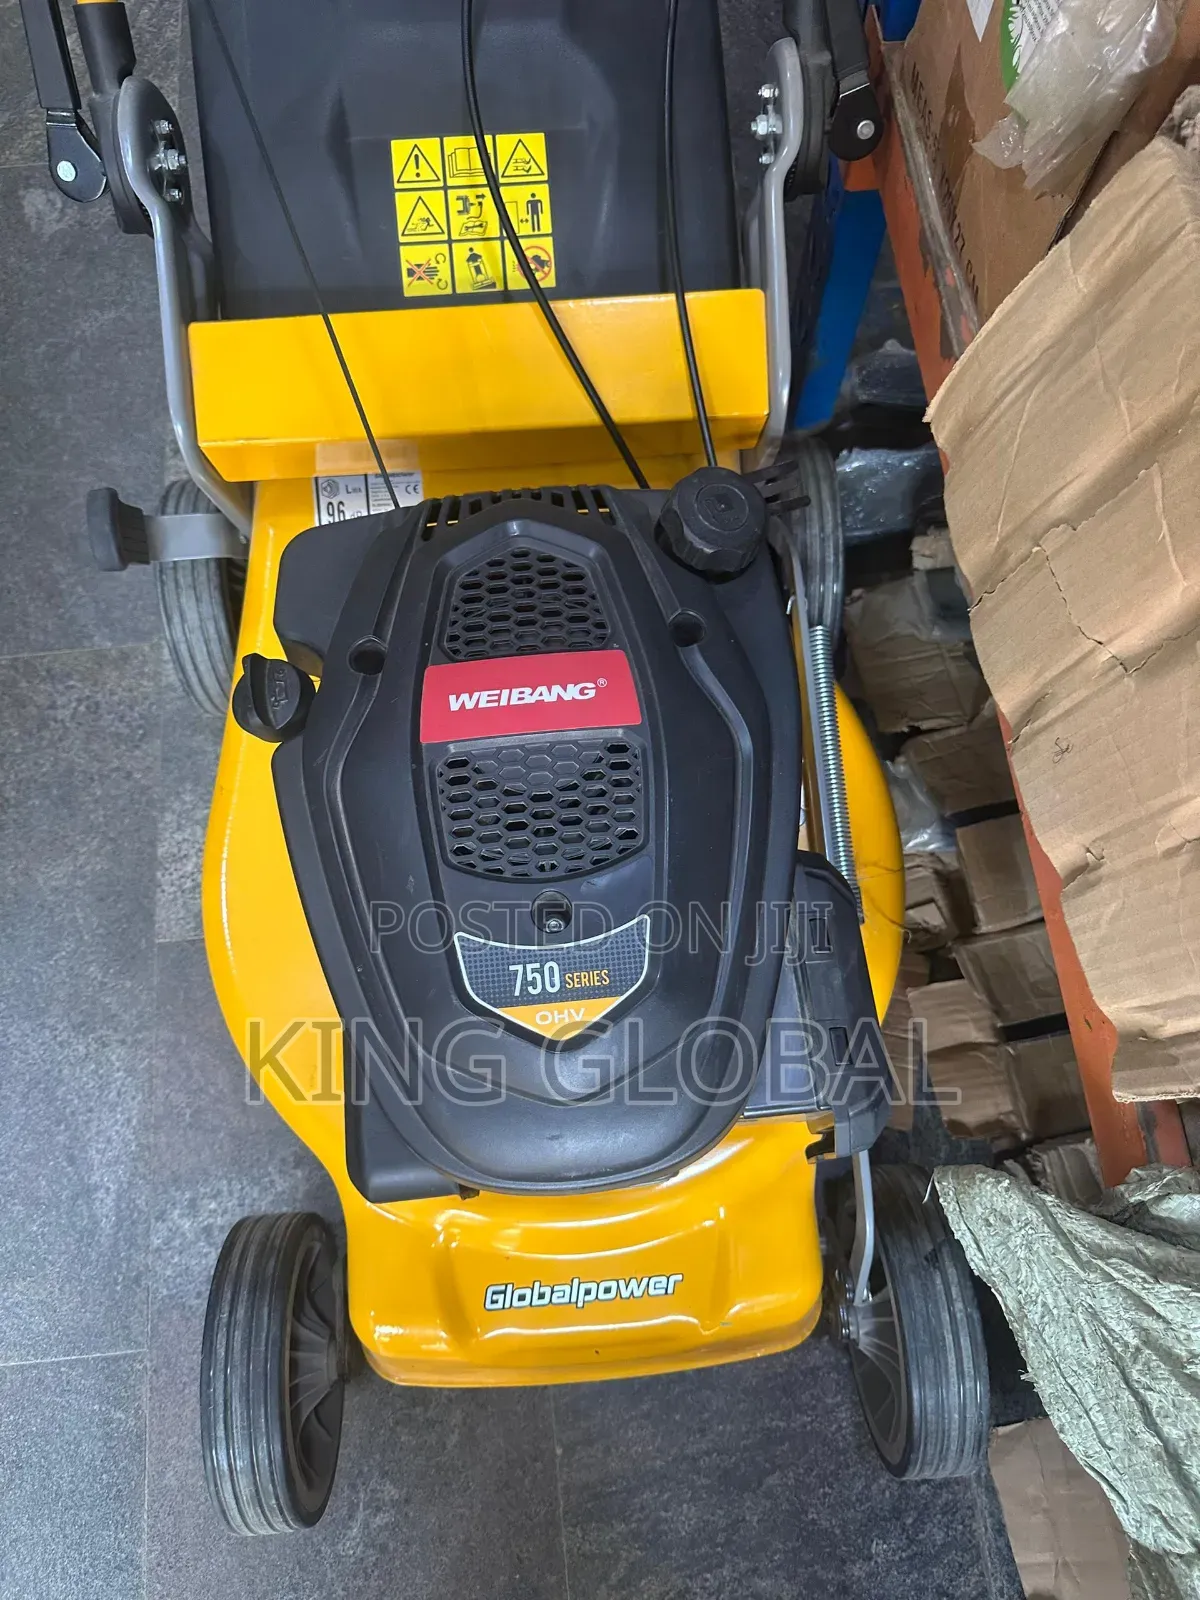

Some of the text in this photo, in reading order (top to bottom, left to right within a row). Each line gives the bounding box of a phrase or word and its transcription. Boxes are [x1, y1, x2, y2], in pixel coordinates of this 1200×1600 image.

[327, 500, 346, 524] 96
[508, 960, 611, 997] 750 SERIES
[535, 1007, 587, 1026] OHV
[484, 1273, 684, 1312] Globalpower
